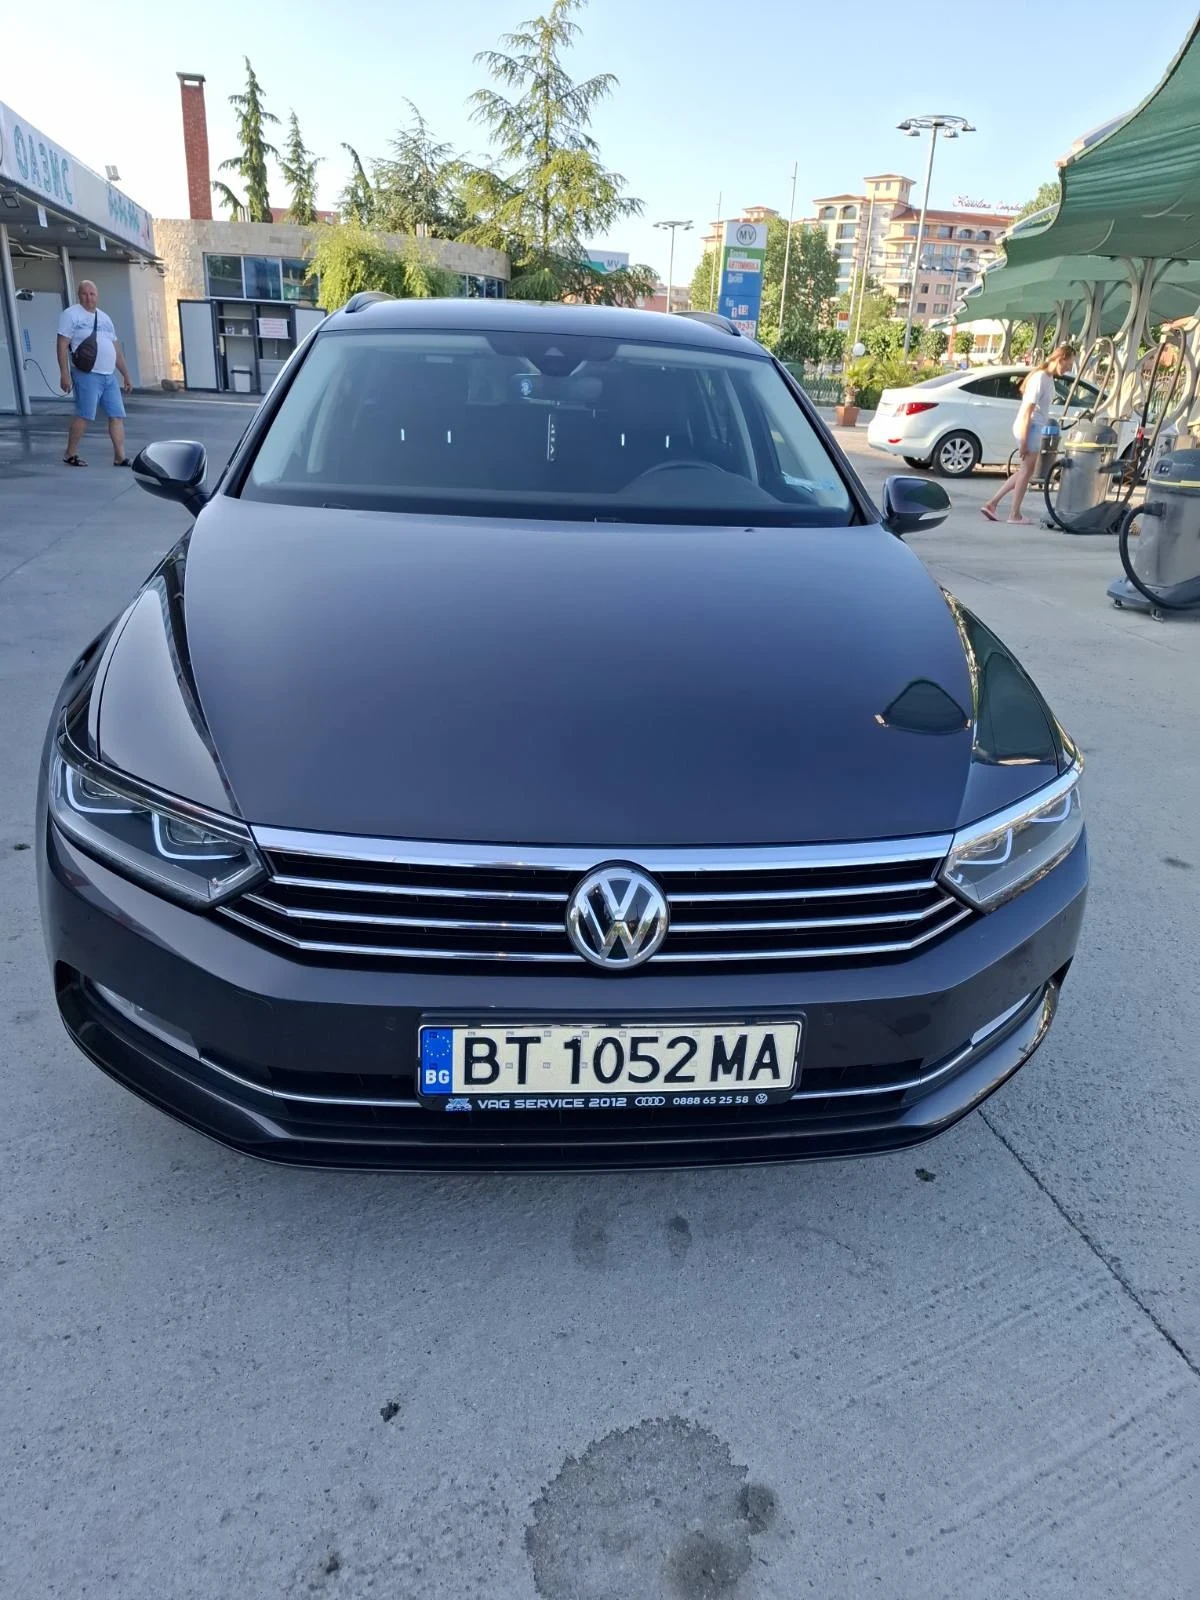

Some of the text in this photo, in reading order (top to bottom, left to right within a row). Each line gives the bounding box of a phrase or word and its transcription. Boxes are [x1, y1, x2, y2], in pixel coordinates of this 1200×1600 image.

[14, 125, 73, 205] ОАЗИС
[463, 1033, 781, 1086] BT 1052 MA
[425, 1070, 450, 1085] BG
[477, 1099, 511, 1109] VAG
[514, 1098, 585, 1109] SERVICE
[588, 1097, 627, 1108] 2012
[673, 1096, 701, 1105] 0888
[702, 1096, 717, 1105] 65
[718, 1096, 733, 1104] 25
[735, 1095, 749, 1104] 58
